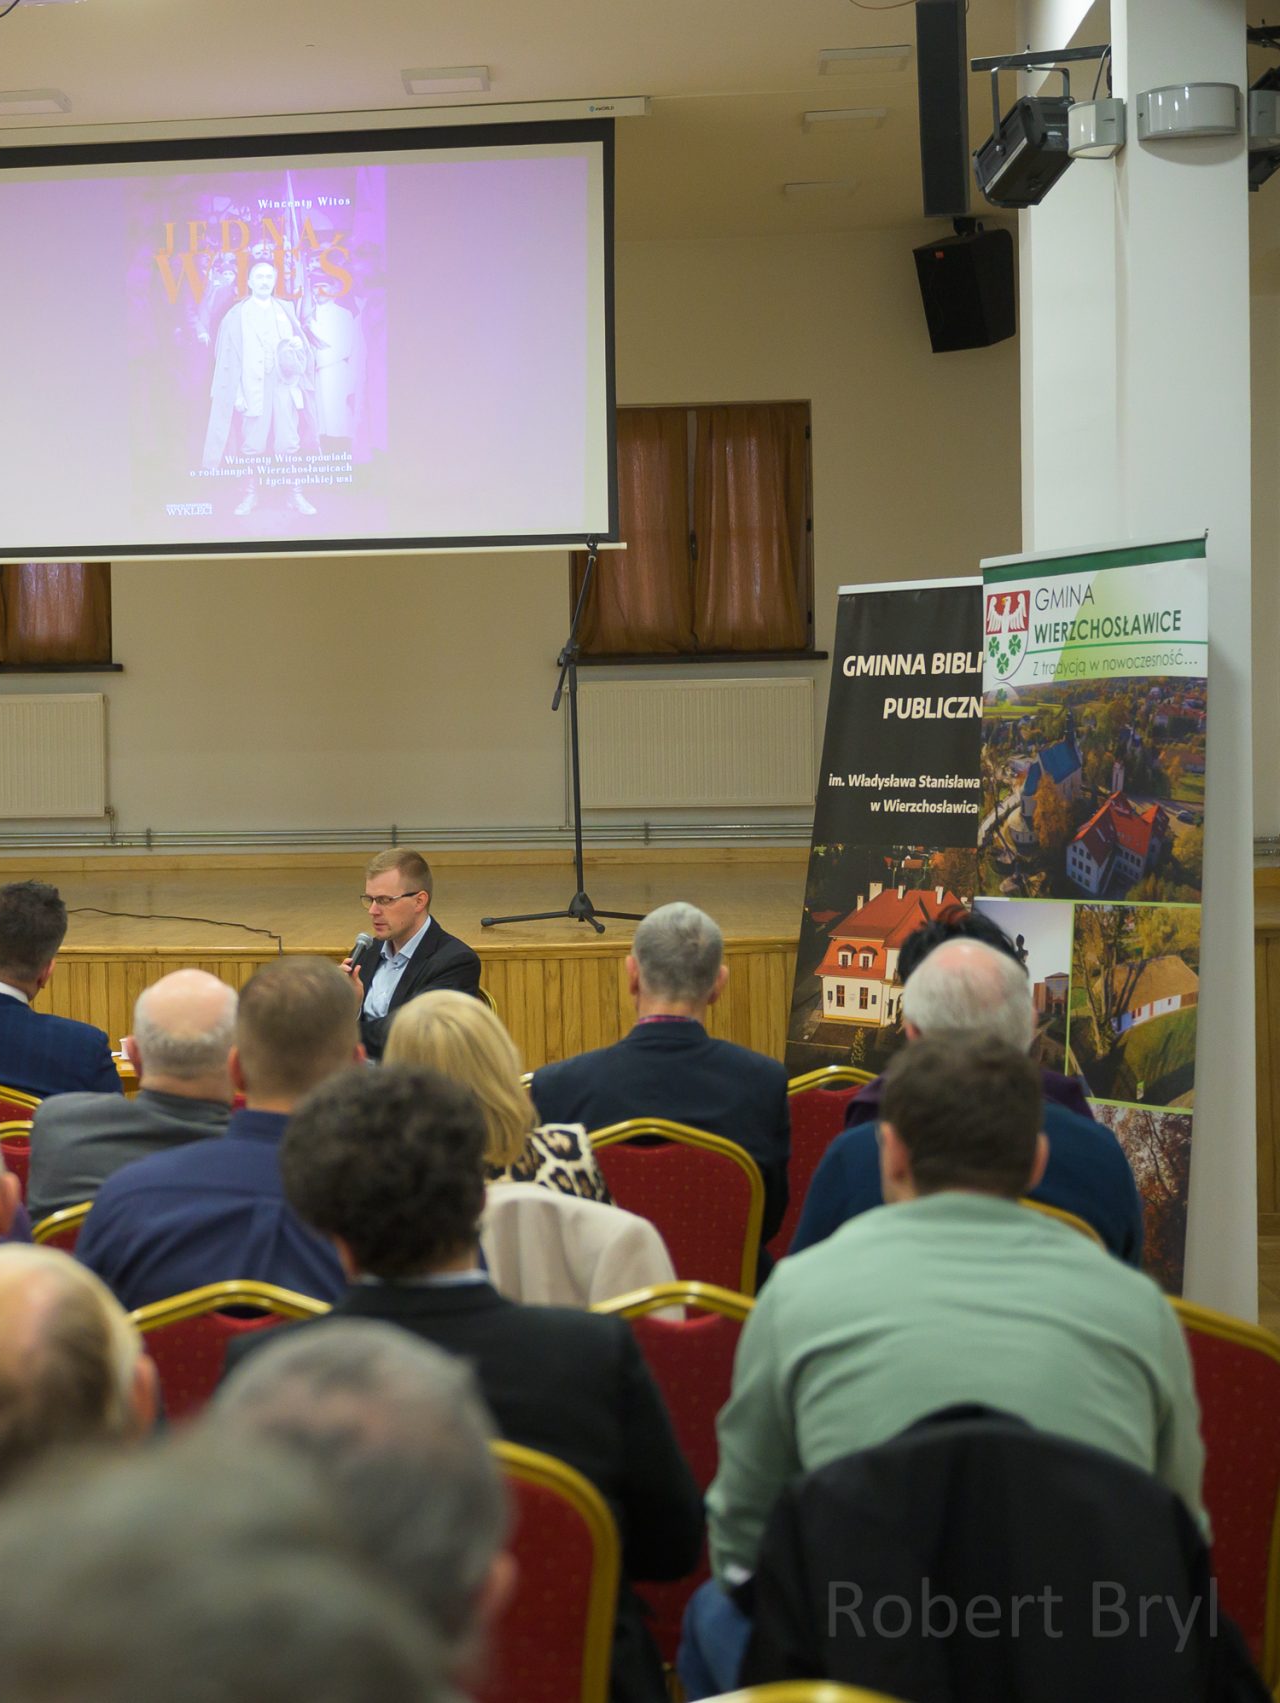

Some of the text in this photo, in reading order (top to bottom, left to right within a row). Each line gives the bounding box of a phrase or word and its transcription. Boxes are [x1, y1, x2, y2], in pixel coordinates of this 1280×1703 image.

[257, 196, 351, 209] Wincenty Witos
[159, 215, 320, 254] JEDNA
[224, 451, 353, 466] Wincenty Witos opowiada
[1035, 583, 1095, 611] GMINA
[1034, 609, 1182, 644] WIERZCHOSŁAWICE
[842, 651, 984, 677] GMINNA BIBLI
[1033, 661, 1039, 676] Z
[1090, 659, 1100, 671] w
[883, 696, 984, 720] PUBLICZN
[828, 772, 981, 790] im. Władysława Stanisława
[870, 799, 980, 814] w Wierzchosławica
